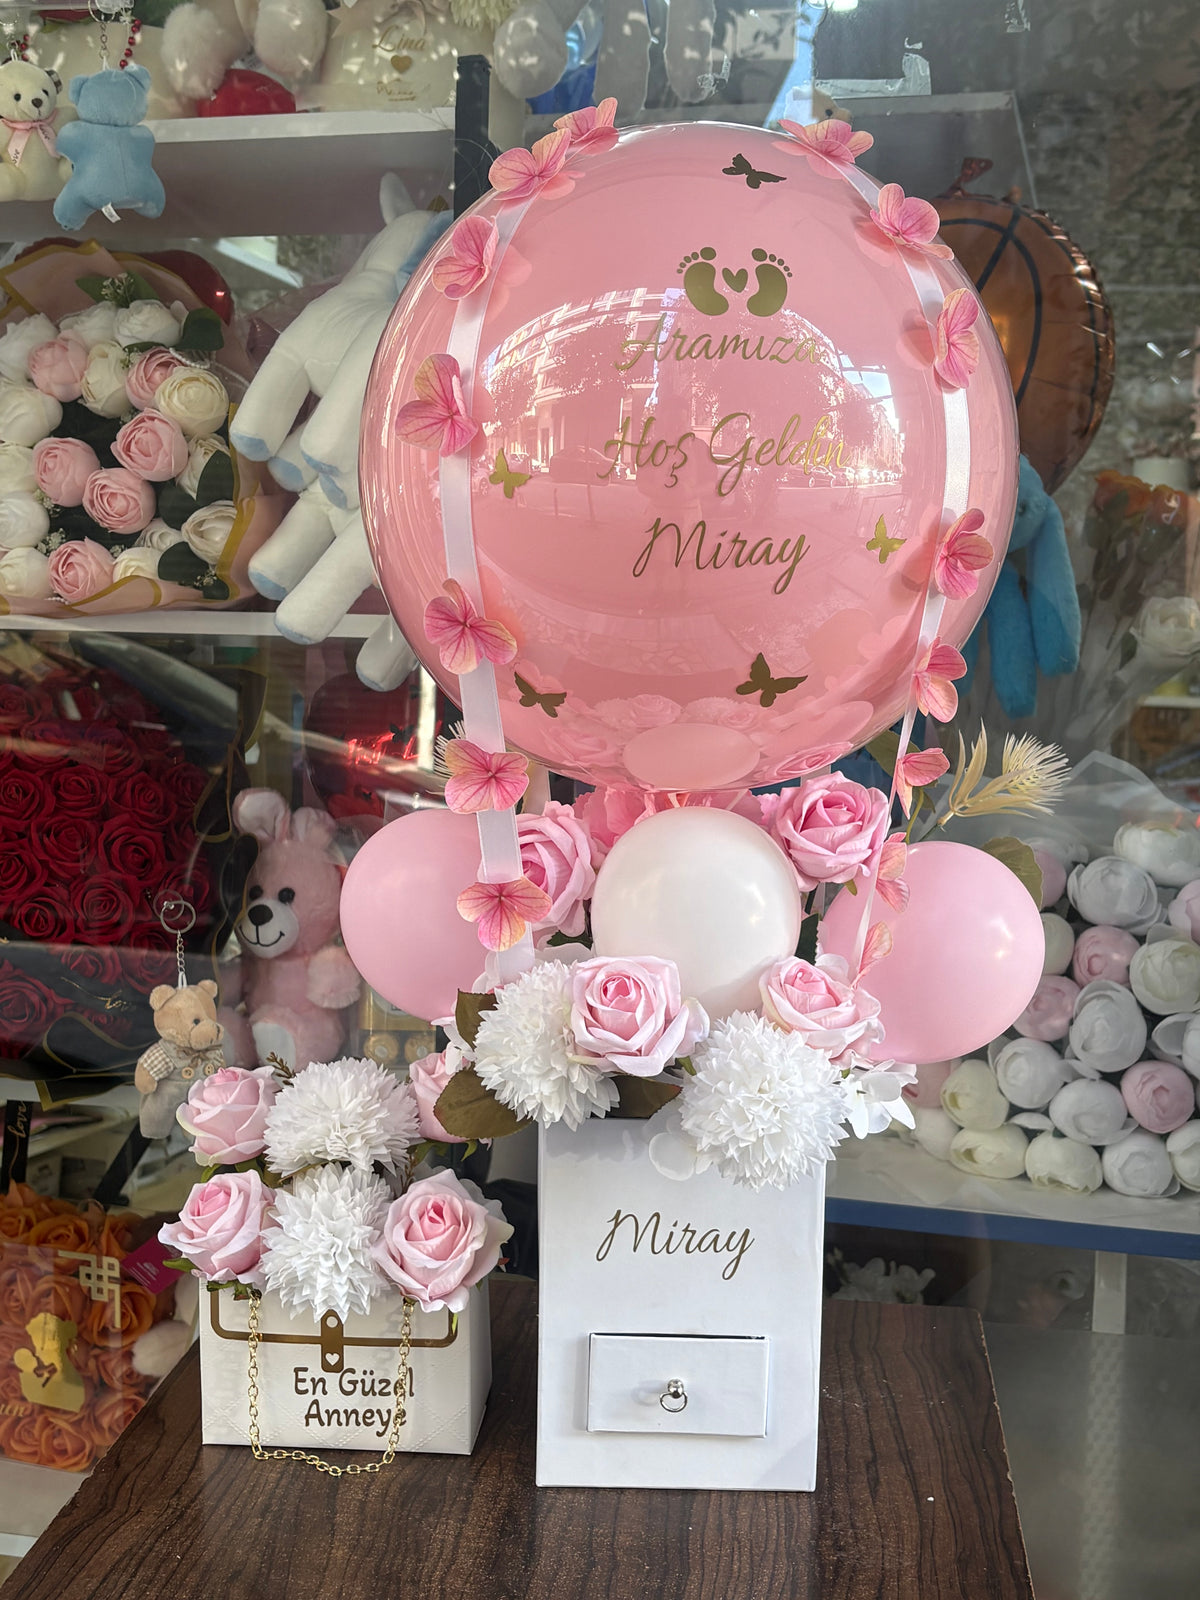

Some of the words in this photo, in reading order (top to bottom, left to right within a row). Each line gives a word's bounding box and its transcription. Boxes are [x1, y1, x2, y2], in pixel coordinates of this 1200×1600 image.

[614, 312, 824, 370] Aramıza
[596, 416, 696, 488] Hoş
[709, 412, 850, 497] Geldin
[632, 517, 811, 595] Miray
[596, 1209, 756, 1281] Miray
[293, 1366, 328, 1396] En
